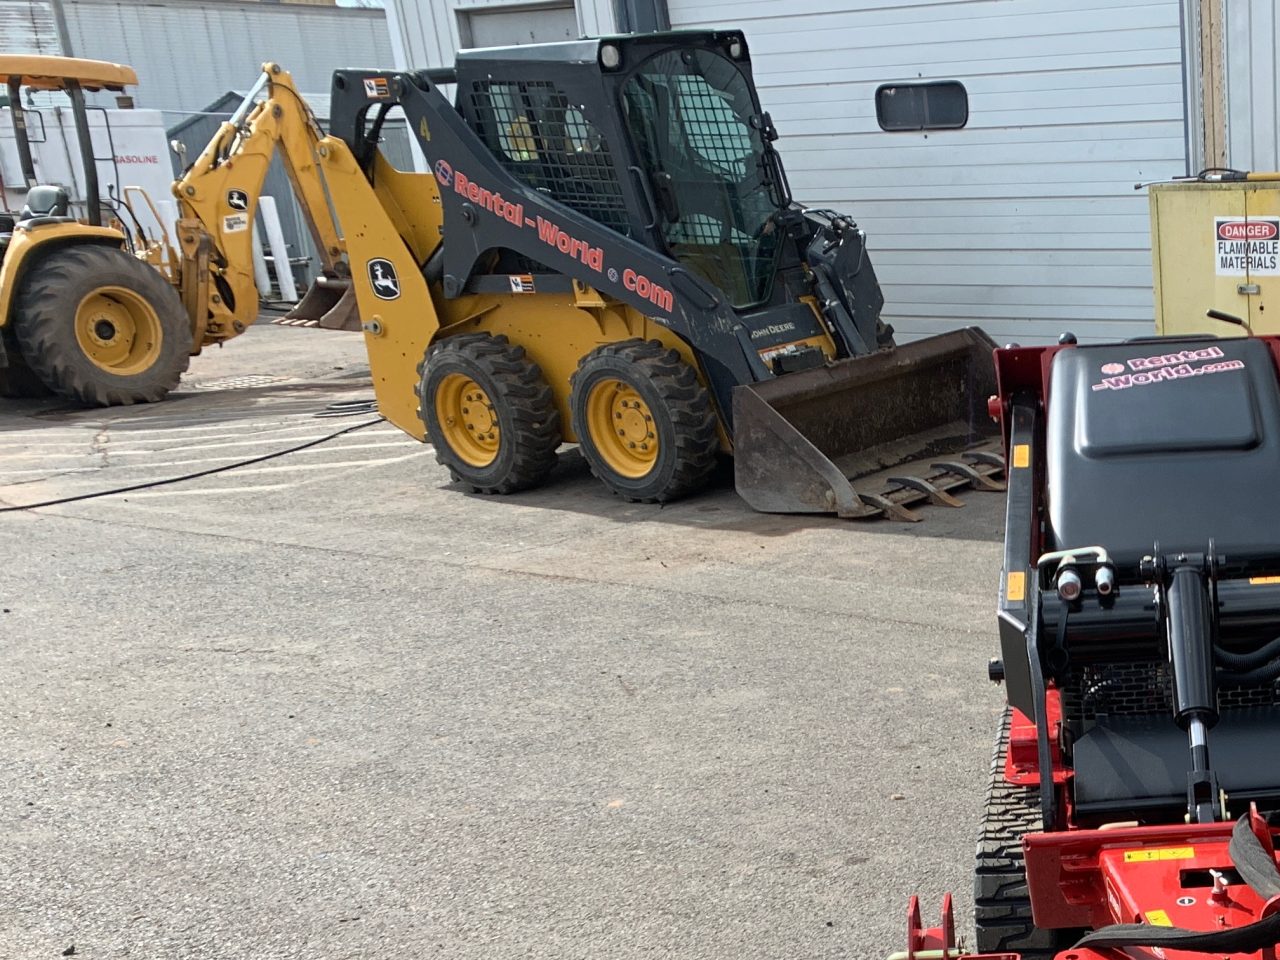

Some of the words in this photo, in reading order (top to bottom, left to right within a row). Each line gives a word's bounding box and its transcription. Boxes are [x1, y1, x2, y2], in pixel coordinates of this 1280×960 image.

[1225, 225, 1270, 237] DANGER
[1218, 241, 1279, 255] FLAMMABLE
[1220, 256, 1277, 269] MATERIALS
[769, 322, 796, 334] DEERE
[1127, 346, 1225, 372] Rental
